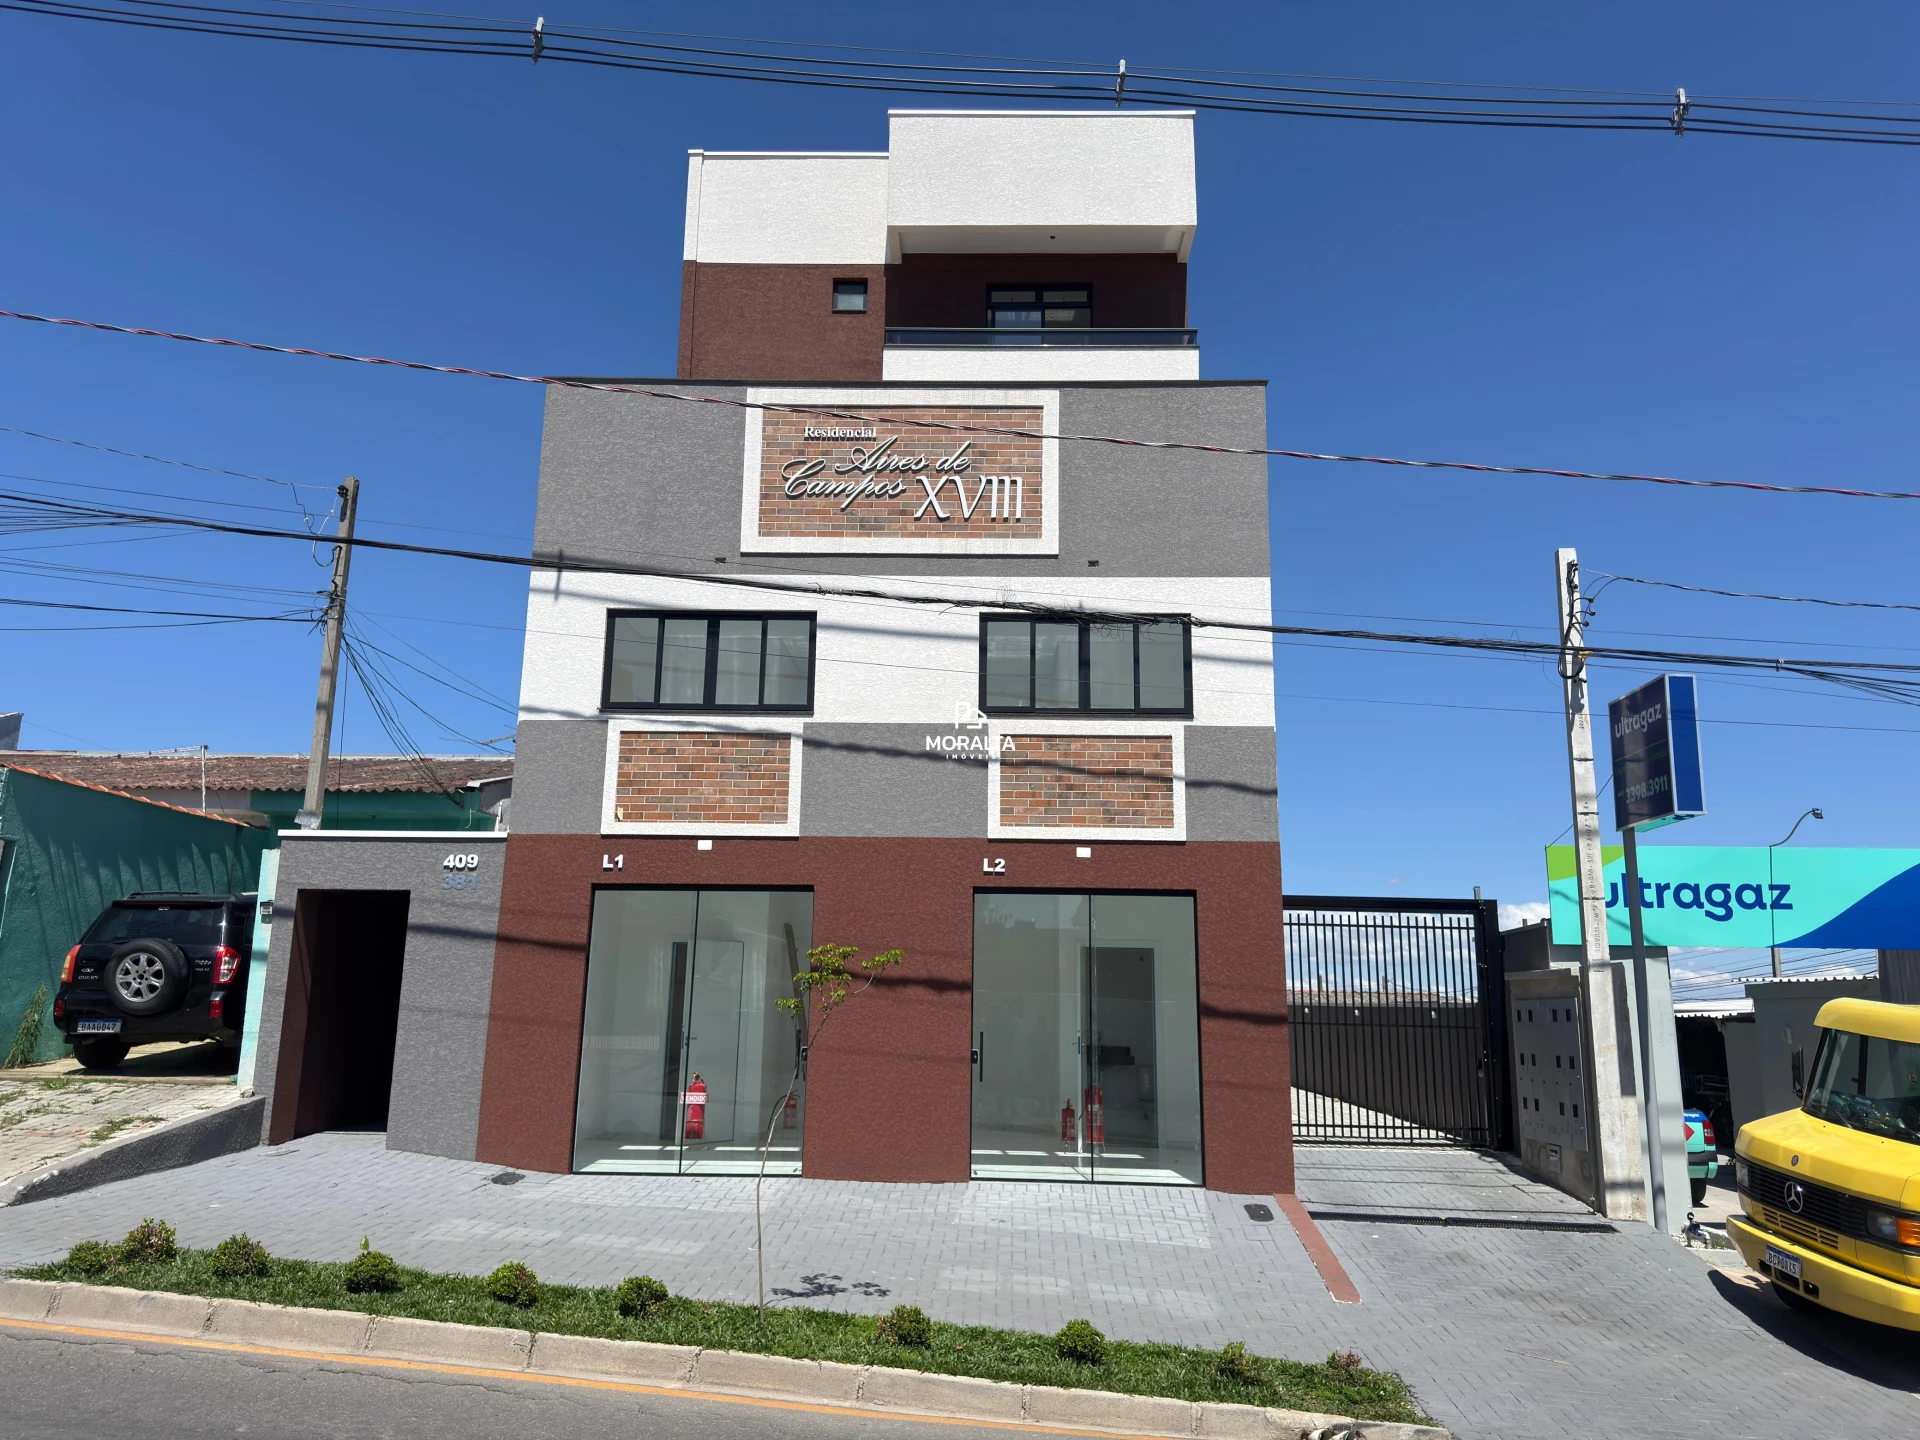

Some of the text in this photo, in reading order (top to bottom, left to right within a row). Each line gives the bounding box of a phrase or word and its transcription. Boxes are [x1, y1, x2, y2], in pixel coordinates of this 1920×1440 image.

[804, 426, 877, 440] Residencial
[835, 435, 972, 473] Aires de
[781, 458, 1023, 520] Campos XVIII
[1614, 703, 1662, 738] ultragaz
[1625, 775, 1669, 804] 3398.3911
[443, 853, 479, 870] 409
[602, 854, 624, 870] L1
[983, 858, 1006, 874] L2
[440, 873, 478, 890] 381
